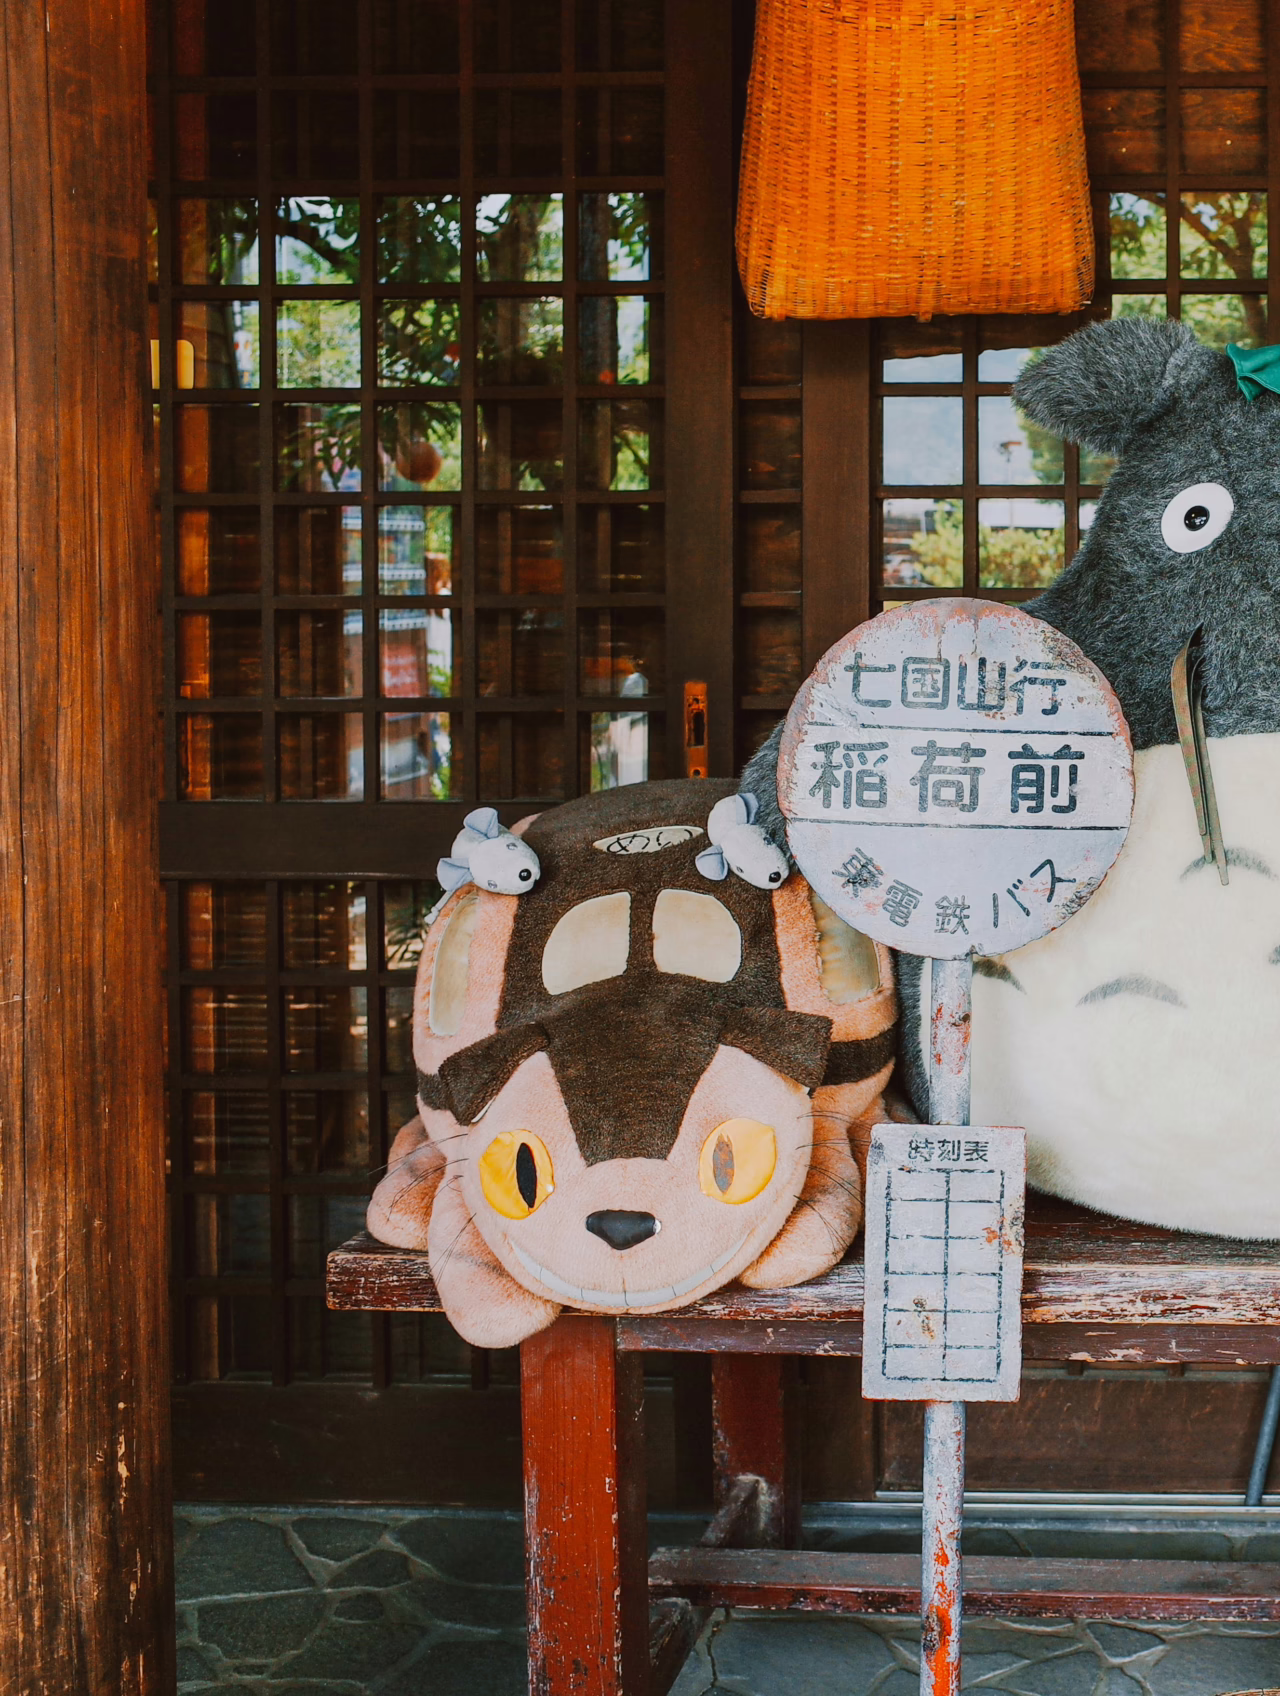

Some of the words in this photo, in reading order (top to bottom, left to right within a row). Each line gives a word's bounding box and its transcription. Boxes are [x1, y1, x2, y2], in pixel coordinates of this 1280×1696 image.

[843, 651, 1067, 716] 七国山行
[808, 740, 1085, 814] 稲荷前
[908, 1138, 989, 1163] 時刻表
